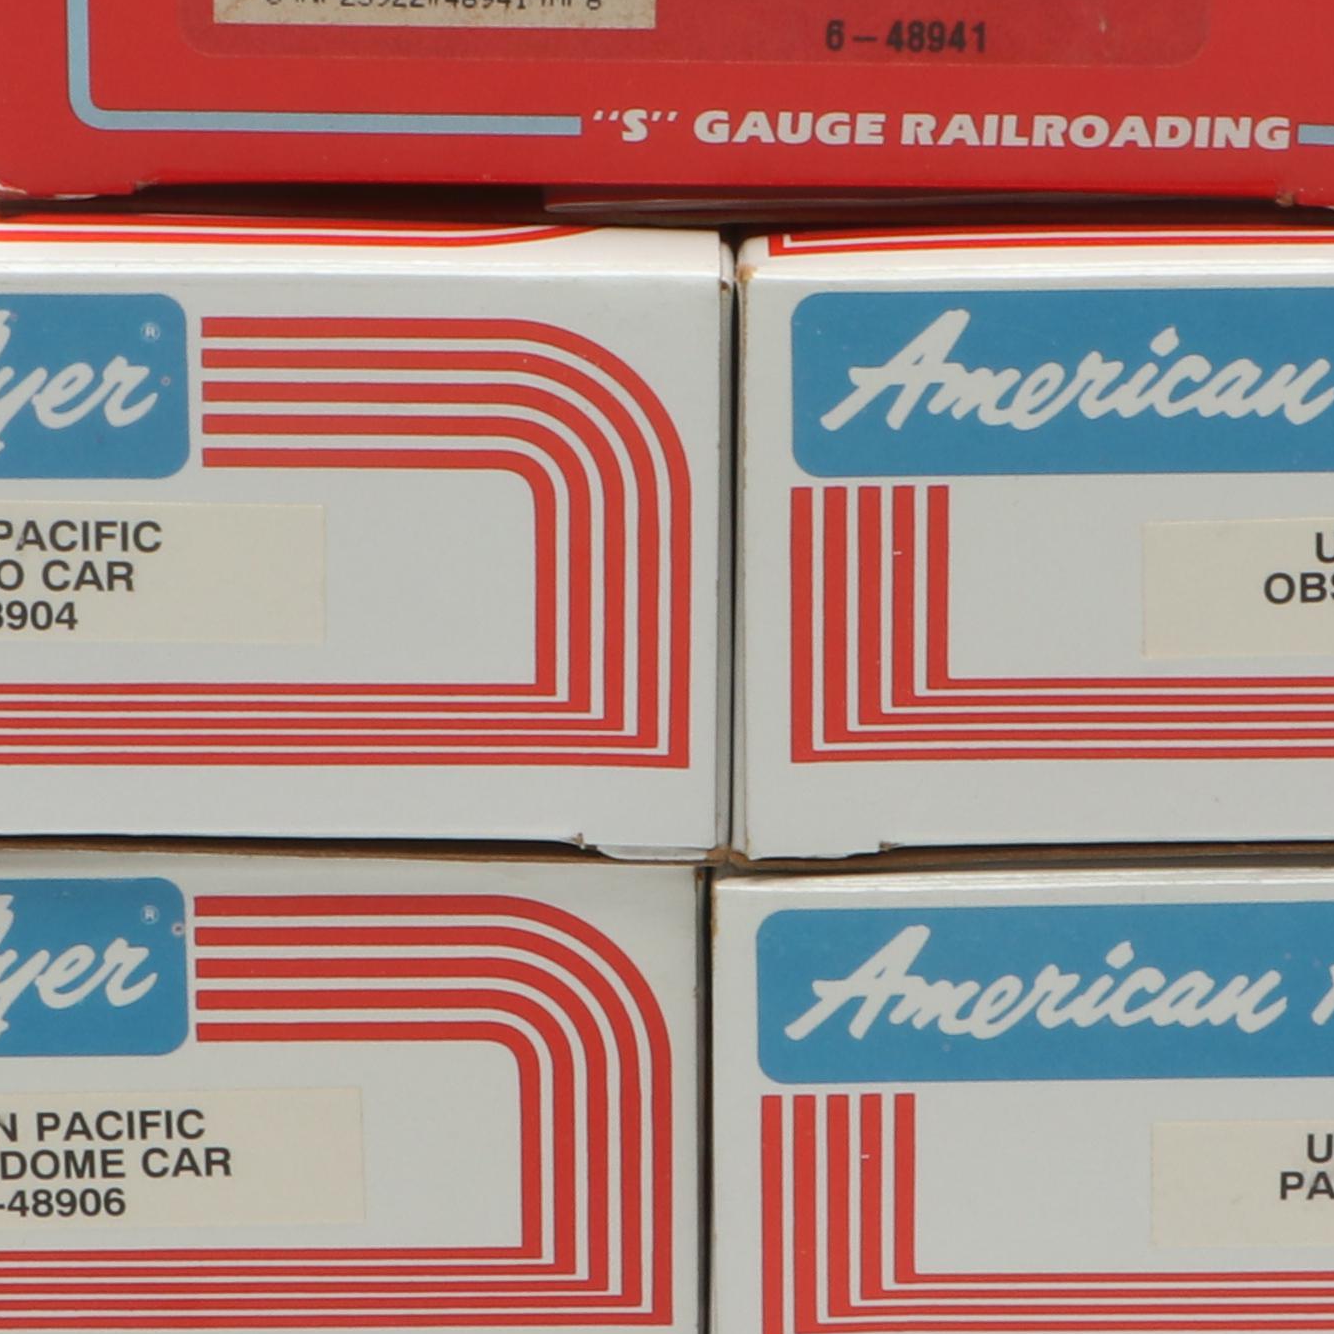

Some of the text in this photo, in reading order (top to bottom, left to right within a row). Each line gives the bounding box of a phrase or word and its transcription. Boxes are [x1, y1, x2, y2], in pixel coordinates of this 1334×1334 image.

[825, 19, 987, 53] 6-48941
[594, 109, 1291, 151] "S" GAUGE RAILROADING
[43, 560, 135, 593] CAR
[784, 924, 1289, 1041] American
[37, 1110, 206, 1143] PACIFIC
[0, 1149, 127, 1181] DOME
[142, 1147, 232, 1179] CAR
